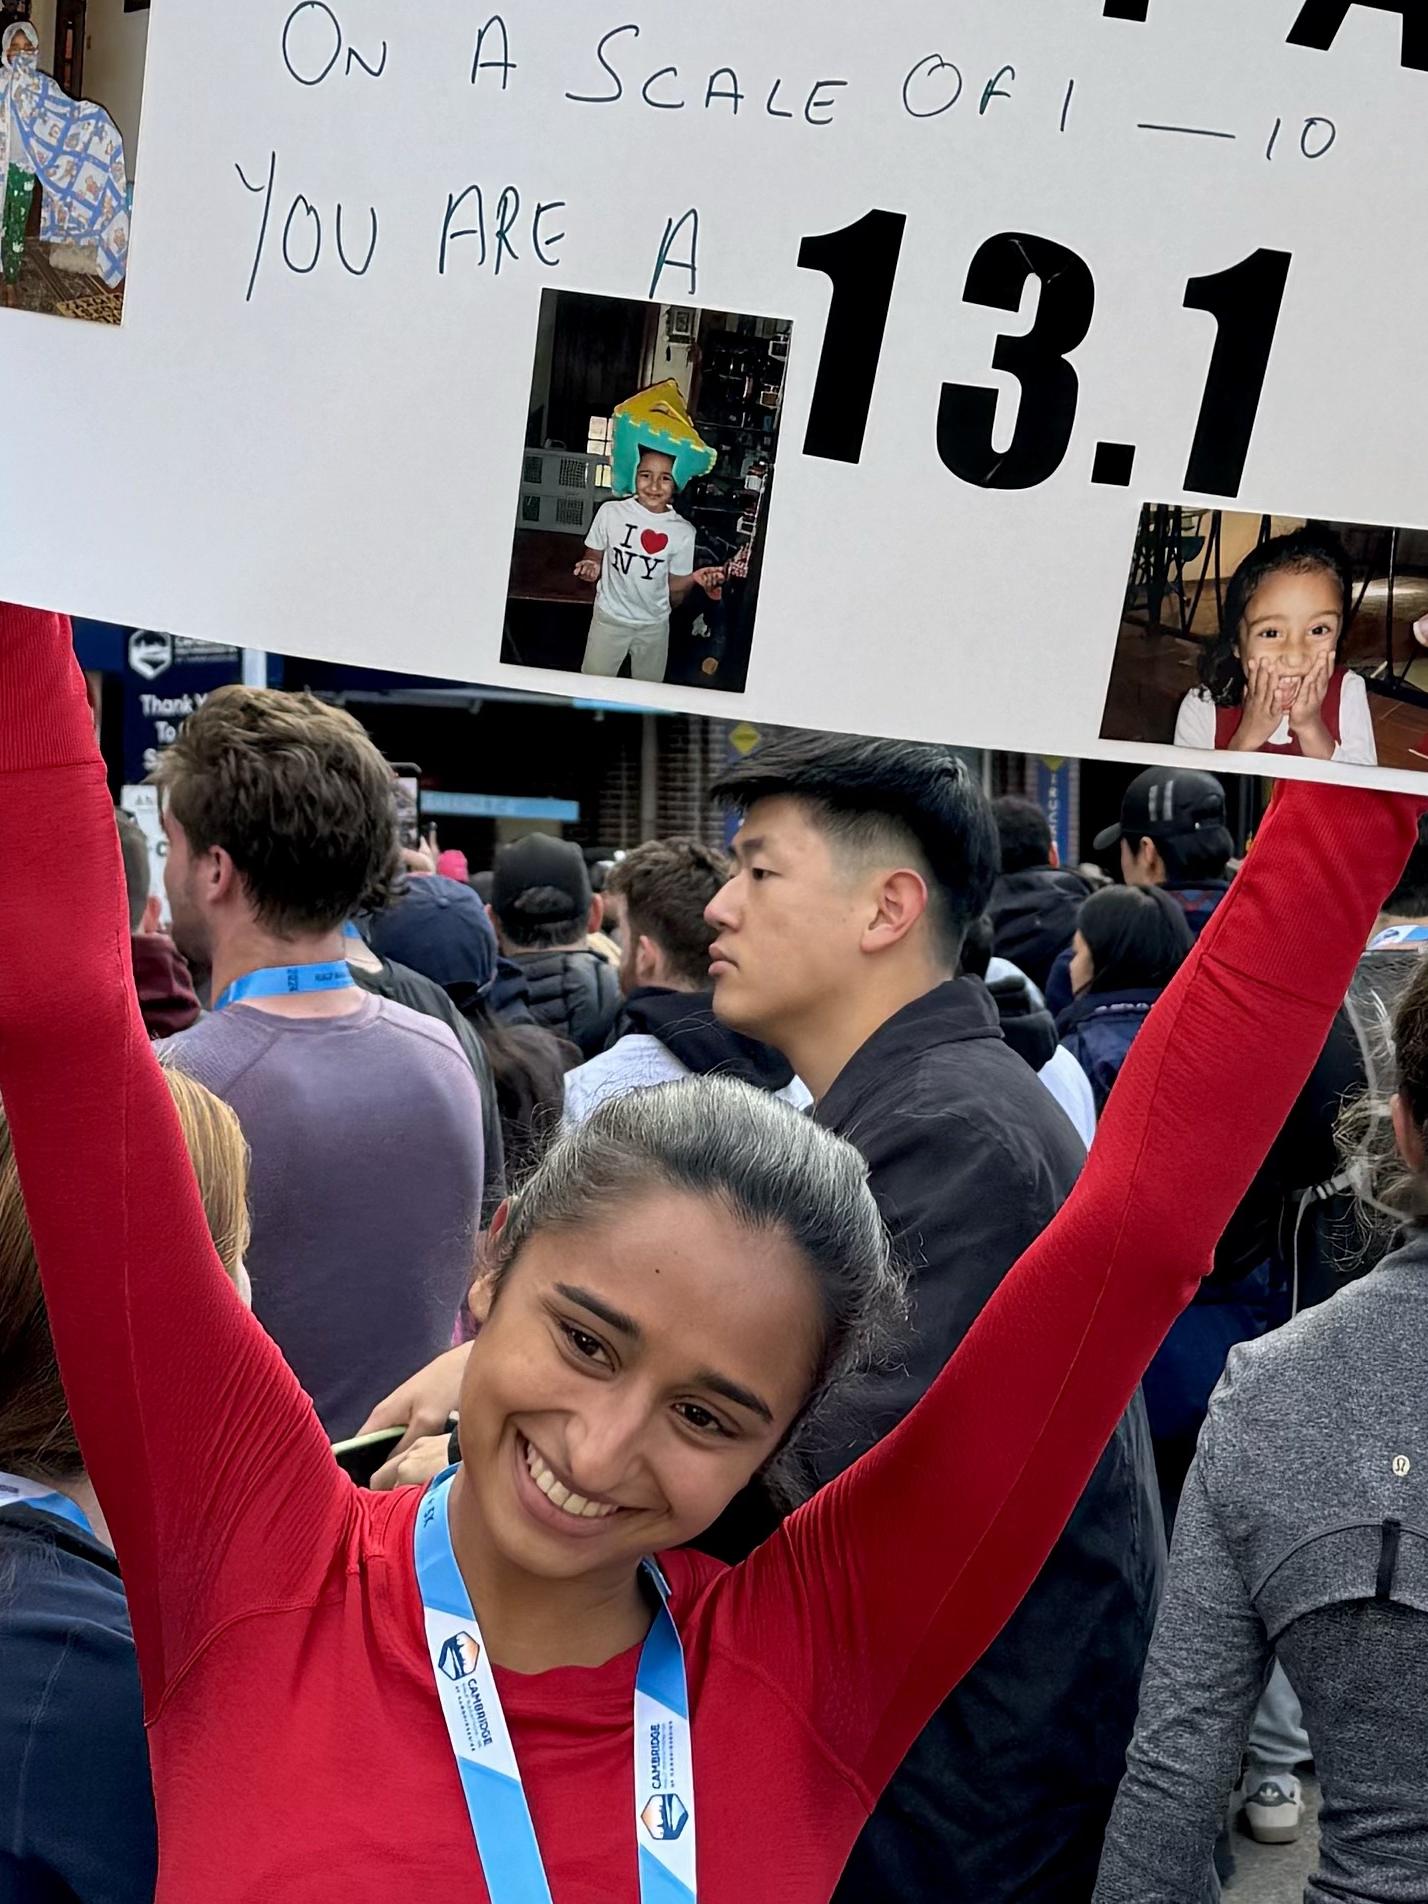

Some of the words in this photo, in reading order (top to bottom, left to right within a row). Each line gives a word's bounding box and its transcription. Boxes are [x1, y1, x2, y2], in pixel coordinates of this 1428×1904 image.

[471, 15, 517, 89] A
[565, 24, 848, 125] SCALE
[1060, 79, 1074, 132] 1
[1267, 117, 1336, 160] 10
[235, 150, 377, 301] YOU
[439, 185, 565, 275] ARE
[649, 208, 698, 299] A
[796, 208, 1292, 498] 13.1
[619, 523, 638, 549] I
[611, 547, 666, 580] NY
[139, 693, 194, 717] Thank
[154, 720, 177, 743] To
[468, 1678, 493, 1747] CAMBRIDGE
[650, 1723, 662, 1789] CAMBRIDGE
